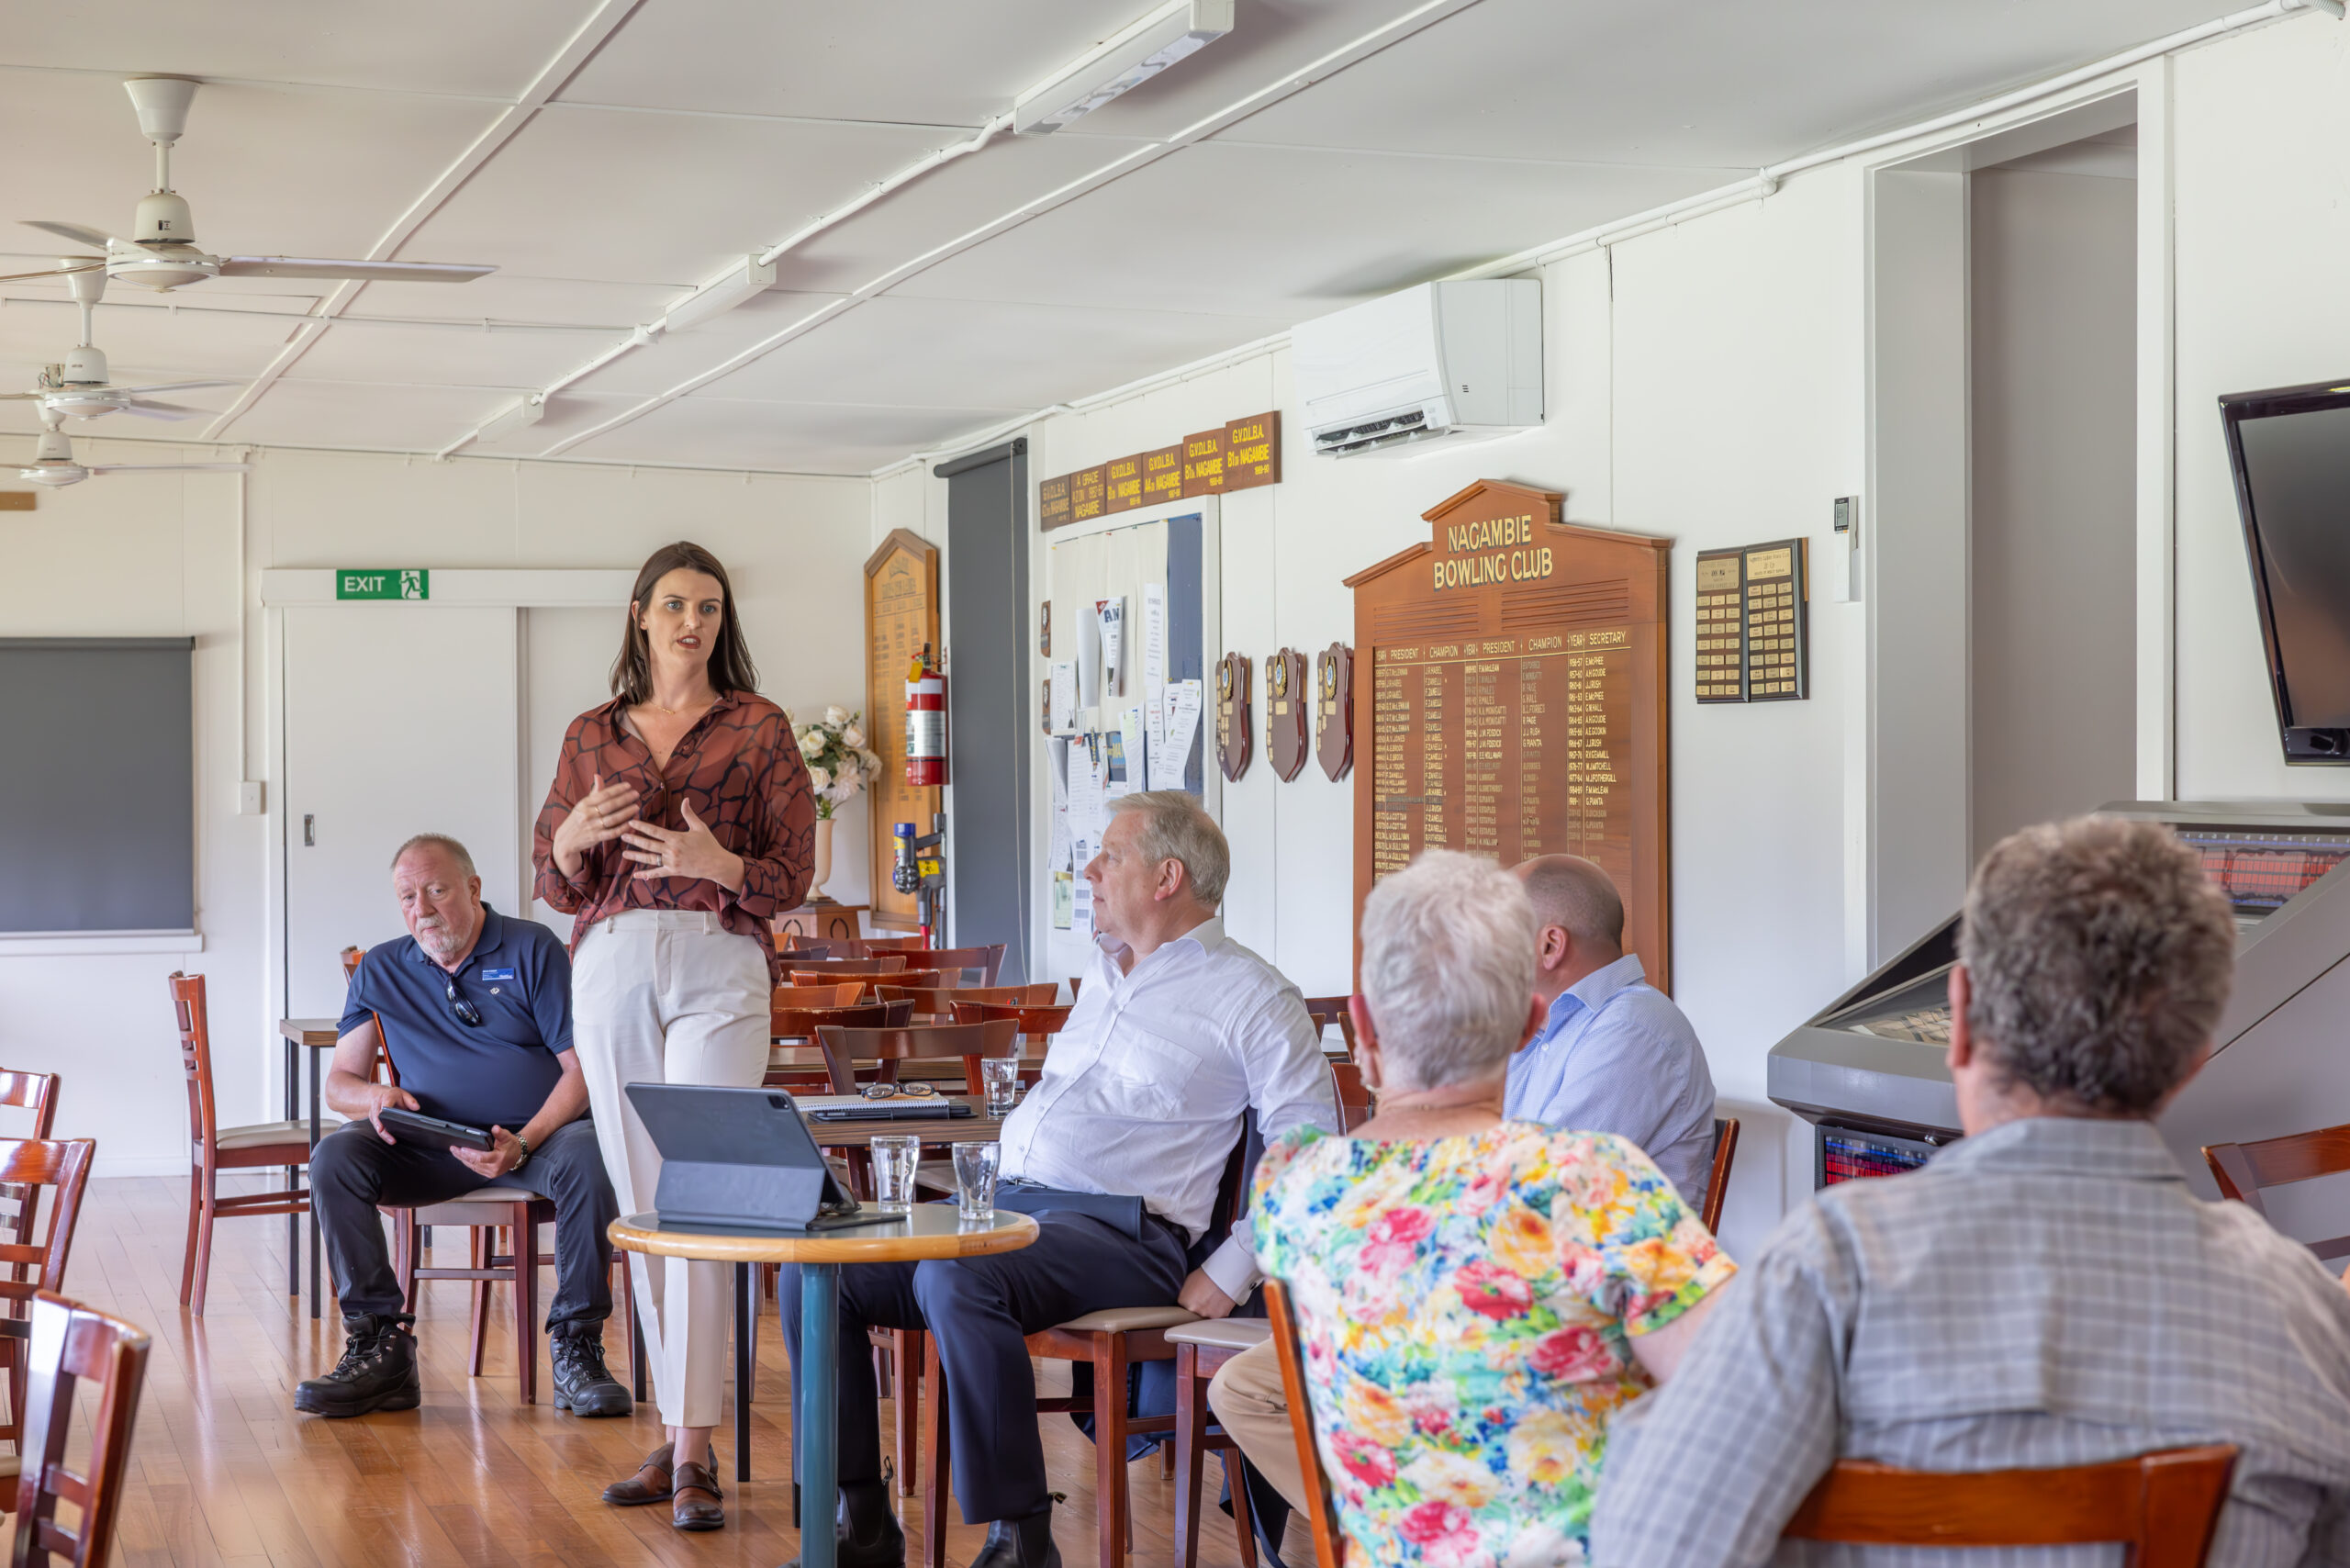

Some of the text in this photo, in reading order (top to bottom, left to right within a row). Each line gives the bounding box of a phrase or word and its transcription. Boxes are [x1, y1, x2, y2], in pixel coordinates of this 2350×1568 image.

[1240, 443, 1270, 465] NAGAMBIE
[1196, 457, 1223, 478] NAGAMBIE
[1118, 478, 1141, 498] NAGAMBIE
[1156, 471, 1181, 491] NAGAMBIE
[1074, 500, 1100, 519] NAGAMBIE
[1448, 514, 1532, 552] NAGAMBIE
[1434, 547, 1553, 591] BOWLING CLUB
[344, 576, 386, 592] EXIT
[1390, 648, 1419, 660] PRESIDENT
[1429, 644, 1458, 658] CHAMPION
[1483, 641, 1515, 655] PRESIDENT
[1528, 635, 1562, 651] CHAMPION
[1570, 634, 1583, 647] YEAR
[1590, 631, 1627, 645] SECRETARY
